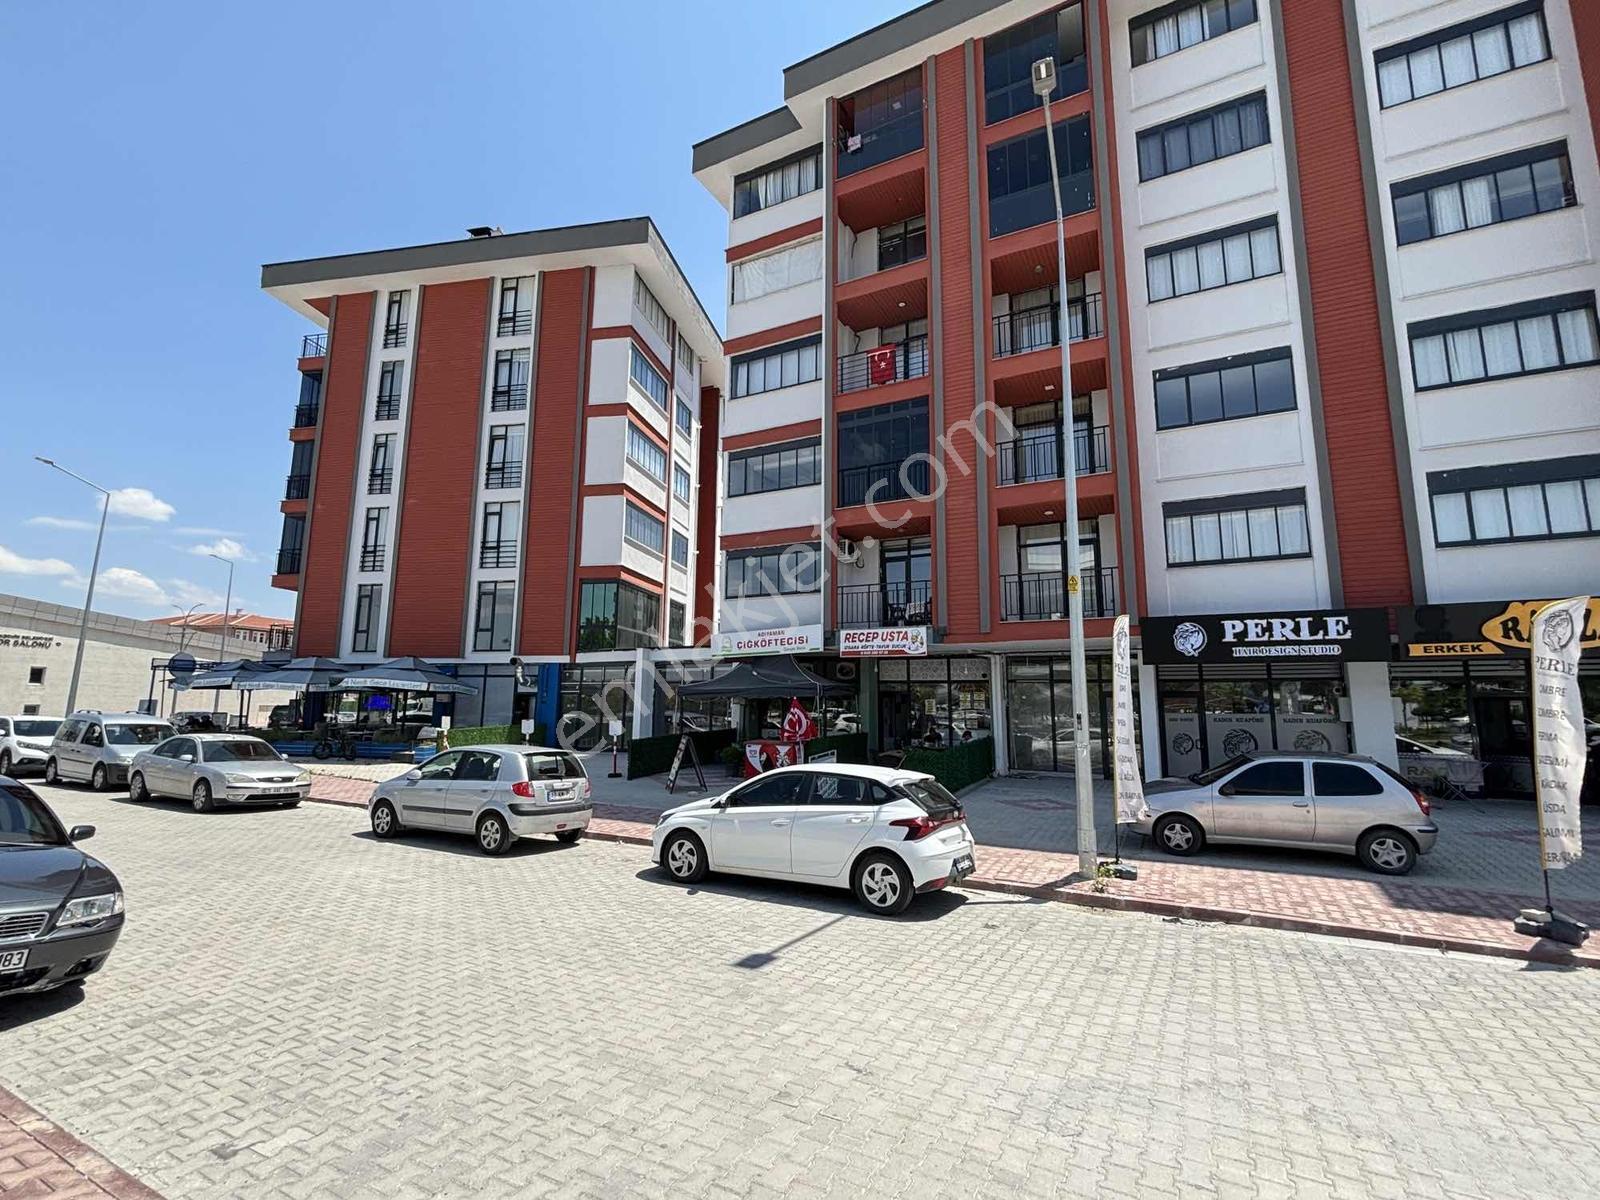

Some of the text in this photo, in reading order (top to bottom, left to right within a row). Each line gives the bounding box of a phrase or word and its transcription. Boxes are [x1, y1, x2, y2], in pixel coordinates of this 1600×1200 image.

[1220, 616, 1352, 642] PERLE
[844, 631, 909, 643] RECEP USTA
[1232, 645, 1341, 657] HAIR DESIGN STUDIO
[1423, 644, 1484, 654] ERKEK
